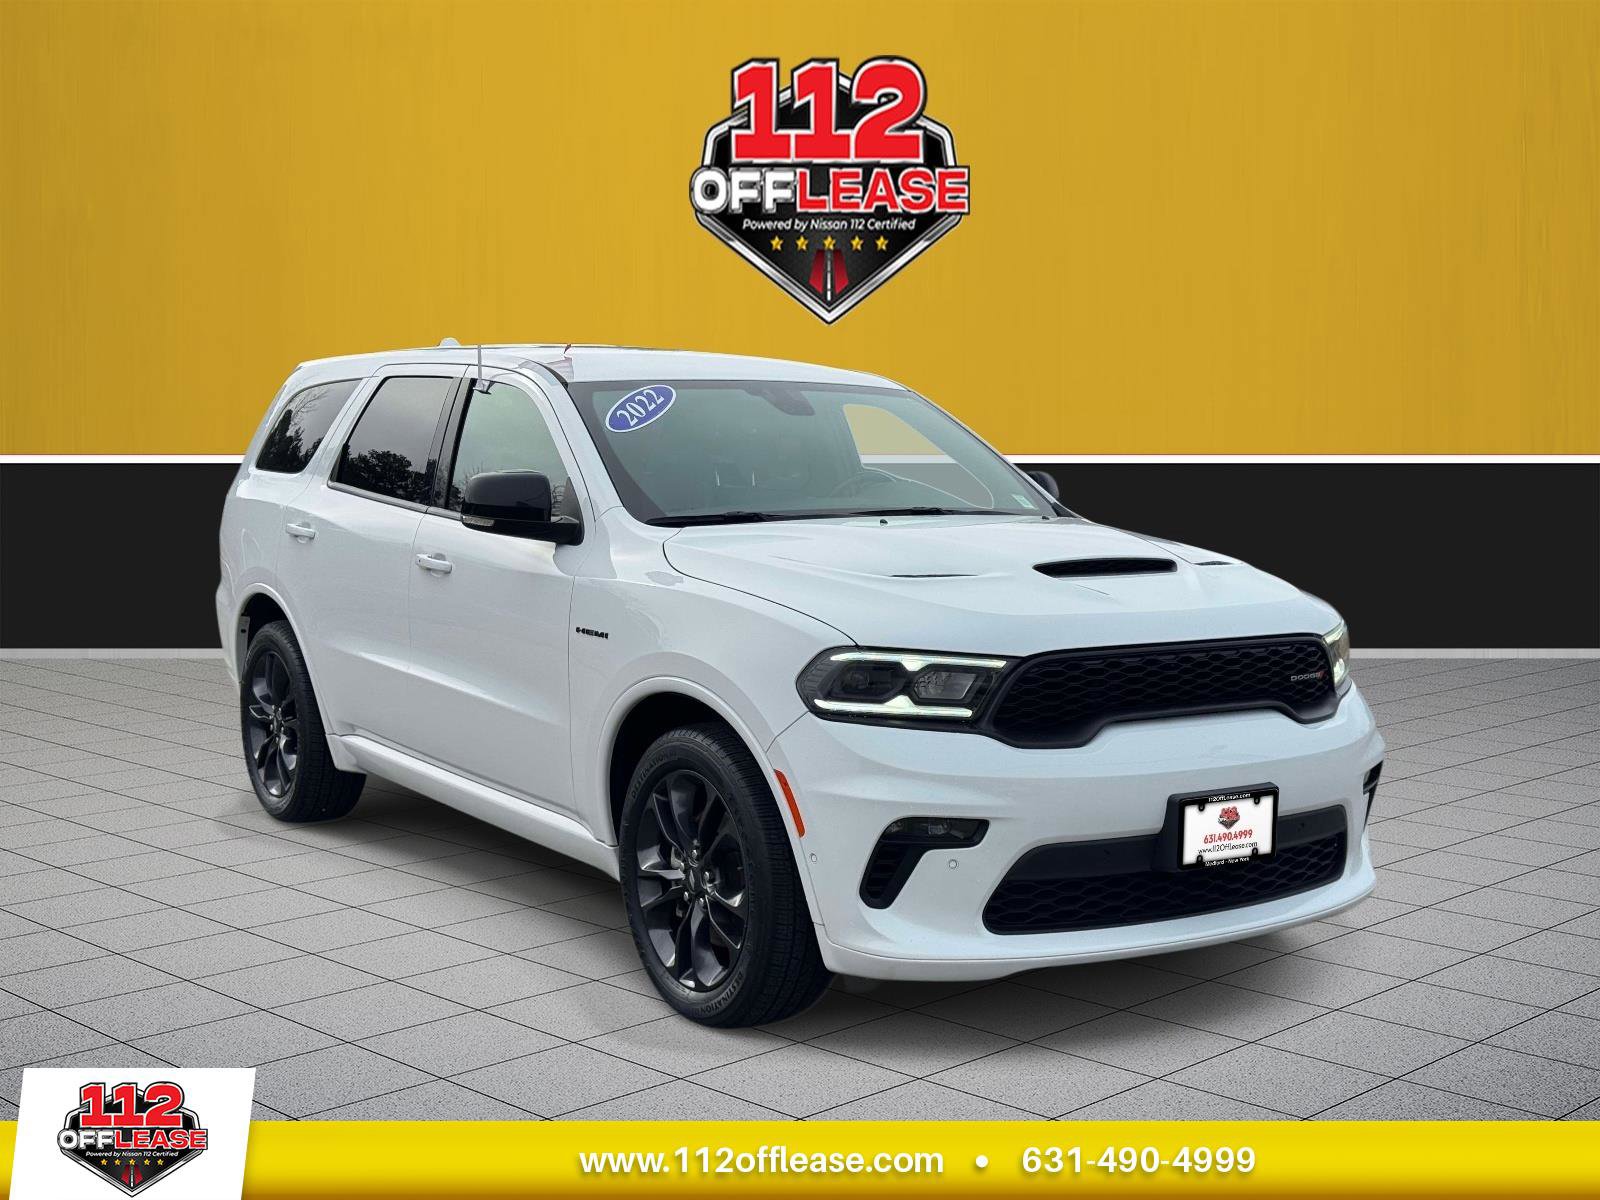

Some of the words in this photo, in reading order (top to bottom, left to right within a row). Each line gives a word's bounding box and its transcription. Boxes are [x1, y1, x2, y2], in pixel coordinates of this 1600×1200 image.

[616, 389, 665, 427] 2022
[576, 627, 608, 639] HEMI
[1290, 671, 1320, 681] DODGE
[1203, 829, 1253, 844] 631.490.4999
